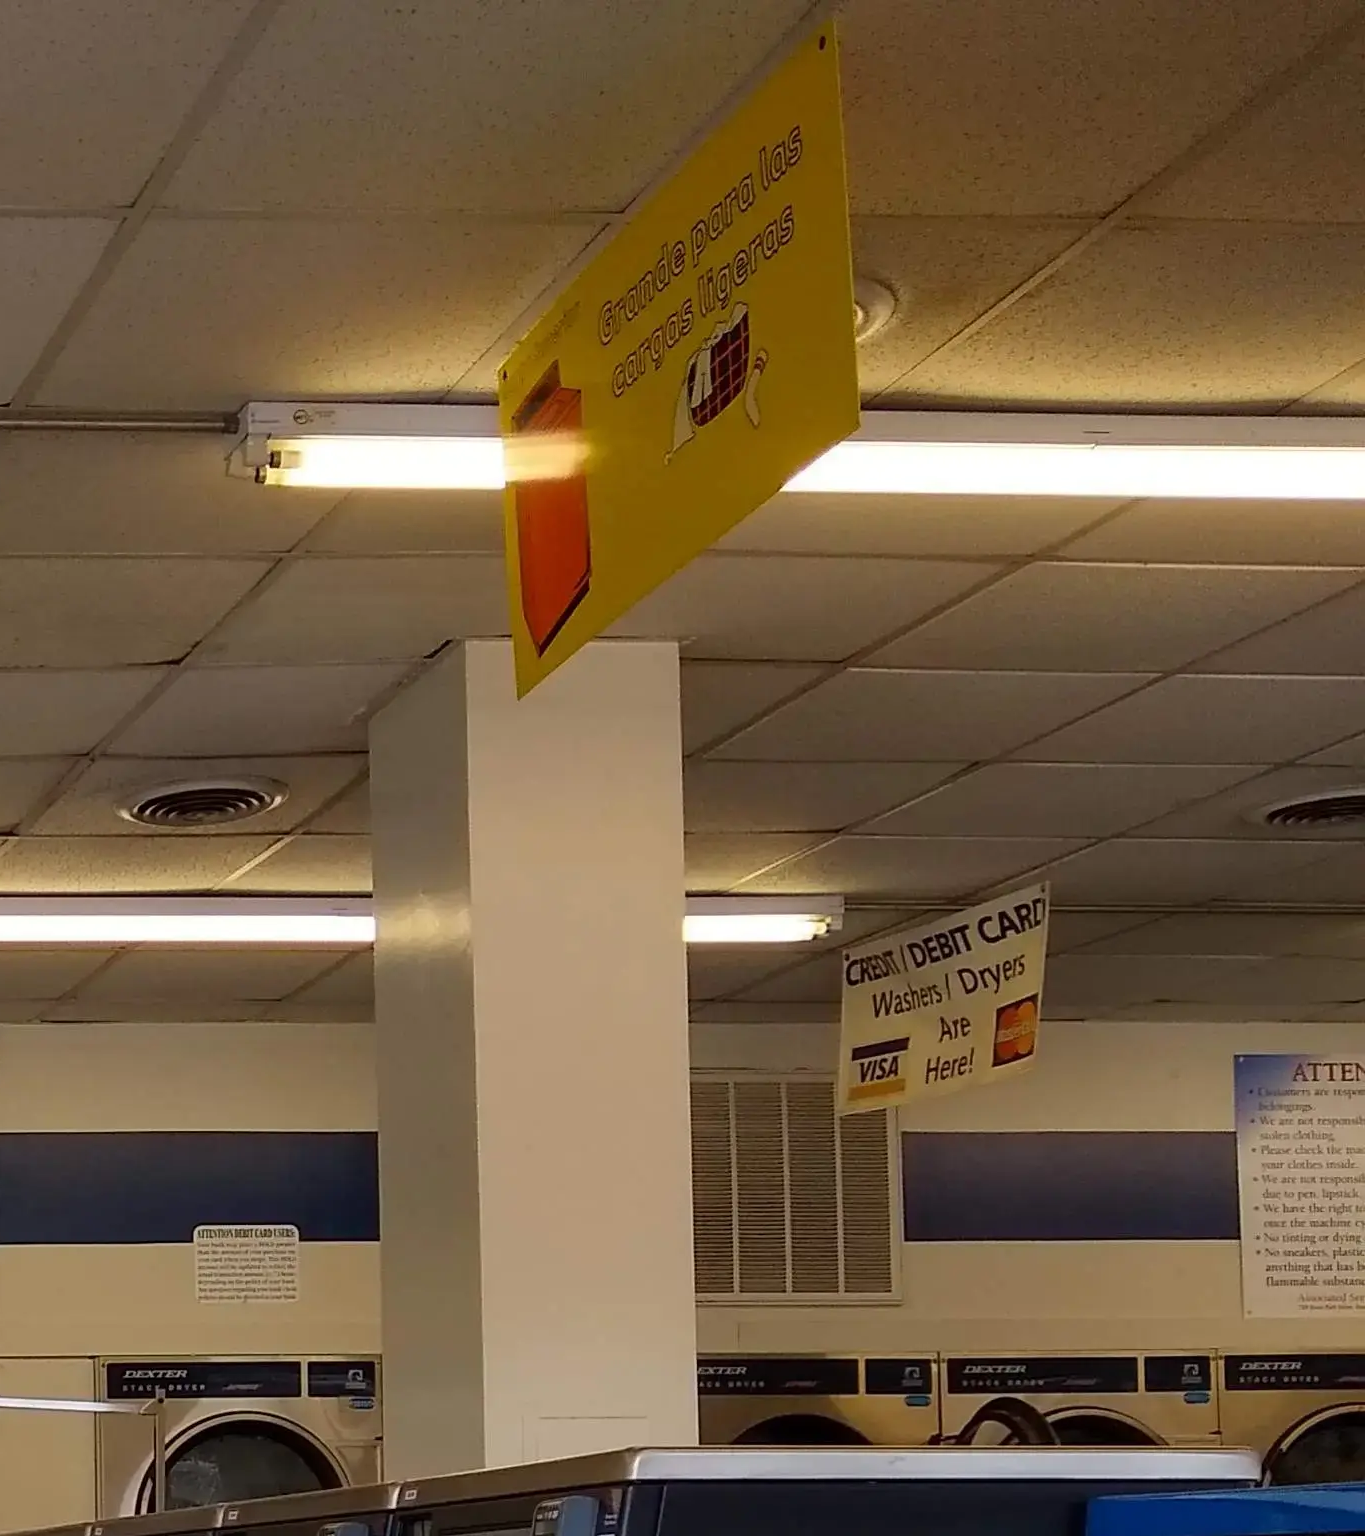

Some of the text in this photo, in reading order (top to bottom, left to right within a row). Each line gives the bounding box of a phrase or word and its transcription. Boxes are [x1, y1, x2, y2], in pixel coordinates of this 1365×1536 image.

[598, 238, 687, 346] Grande
[690, 171, 755, 267] para
[759, 125, 803, 190] las
[611, 300, 695, 398] cargas
[698, 204, 795, 318] ligeras
[845, 951, 900, 986] CREDIT
[906, 924, 972, 969] DEBIT
[872, 982, 943, 1018] Washers
[957, 954, 1026, 995] Dryers
[939, 1016, 972, 1043] Are
[859, 1055, 900, 1083] VISA
[925, 1047, 975, 1085] Here!
[122, 1370, 188, 1379] DEXTER
[697, 1366, 747, 1375] EXTER
[962, 1365, 1027, 1374] DEXTER
[1239, 1361, 1303, 1370] DEXTER
